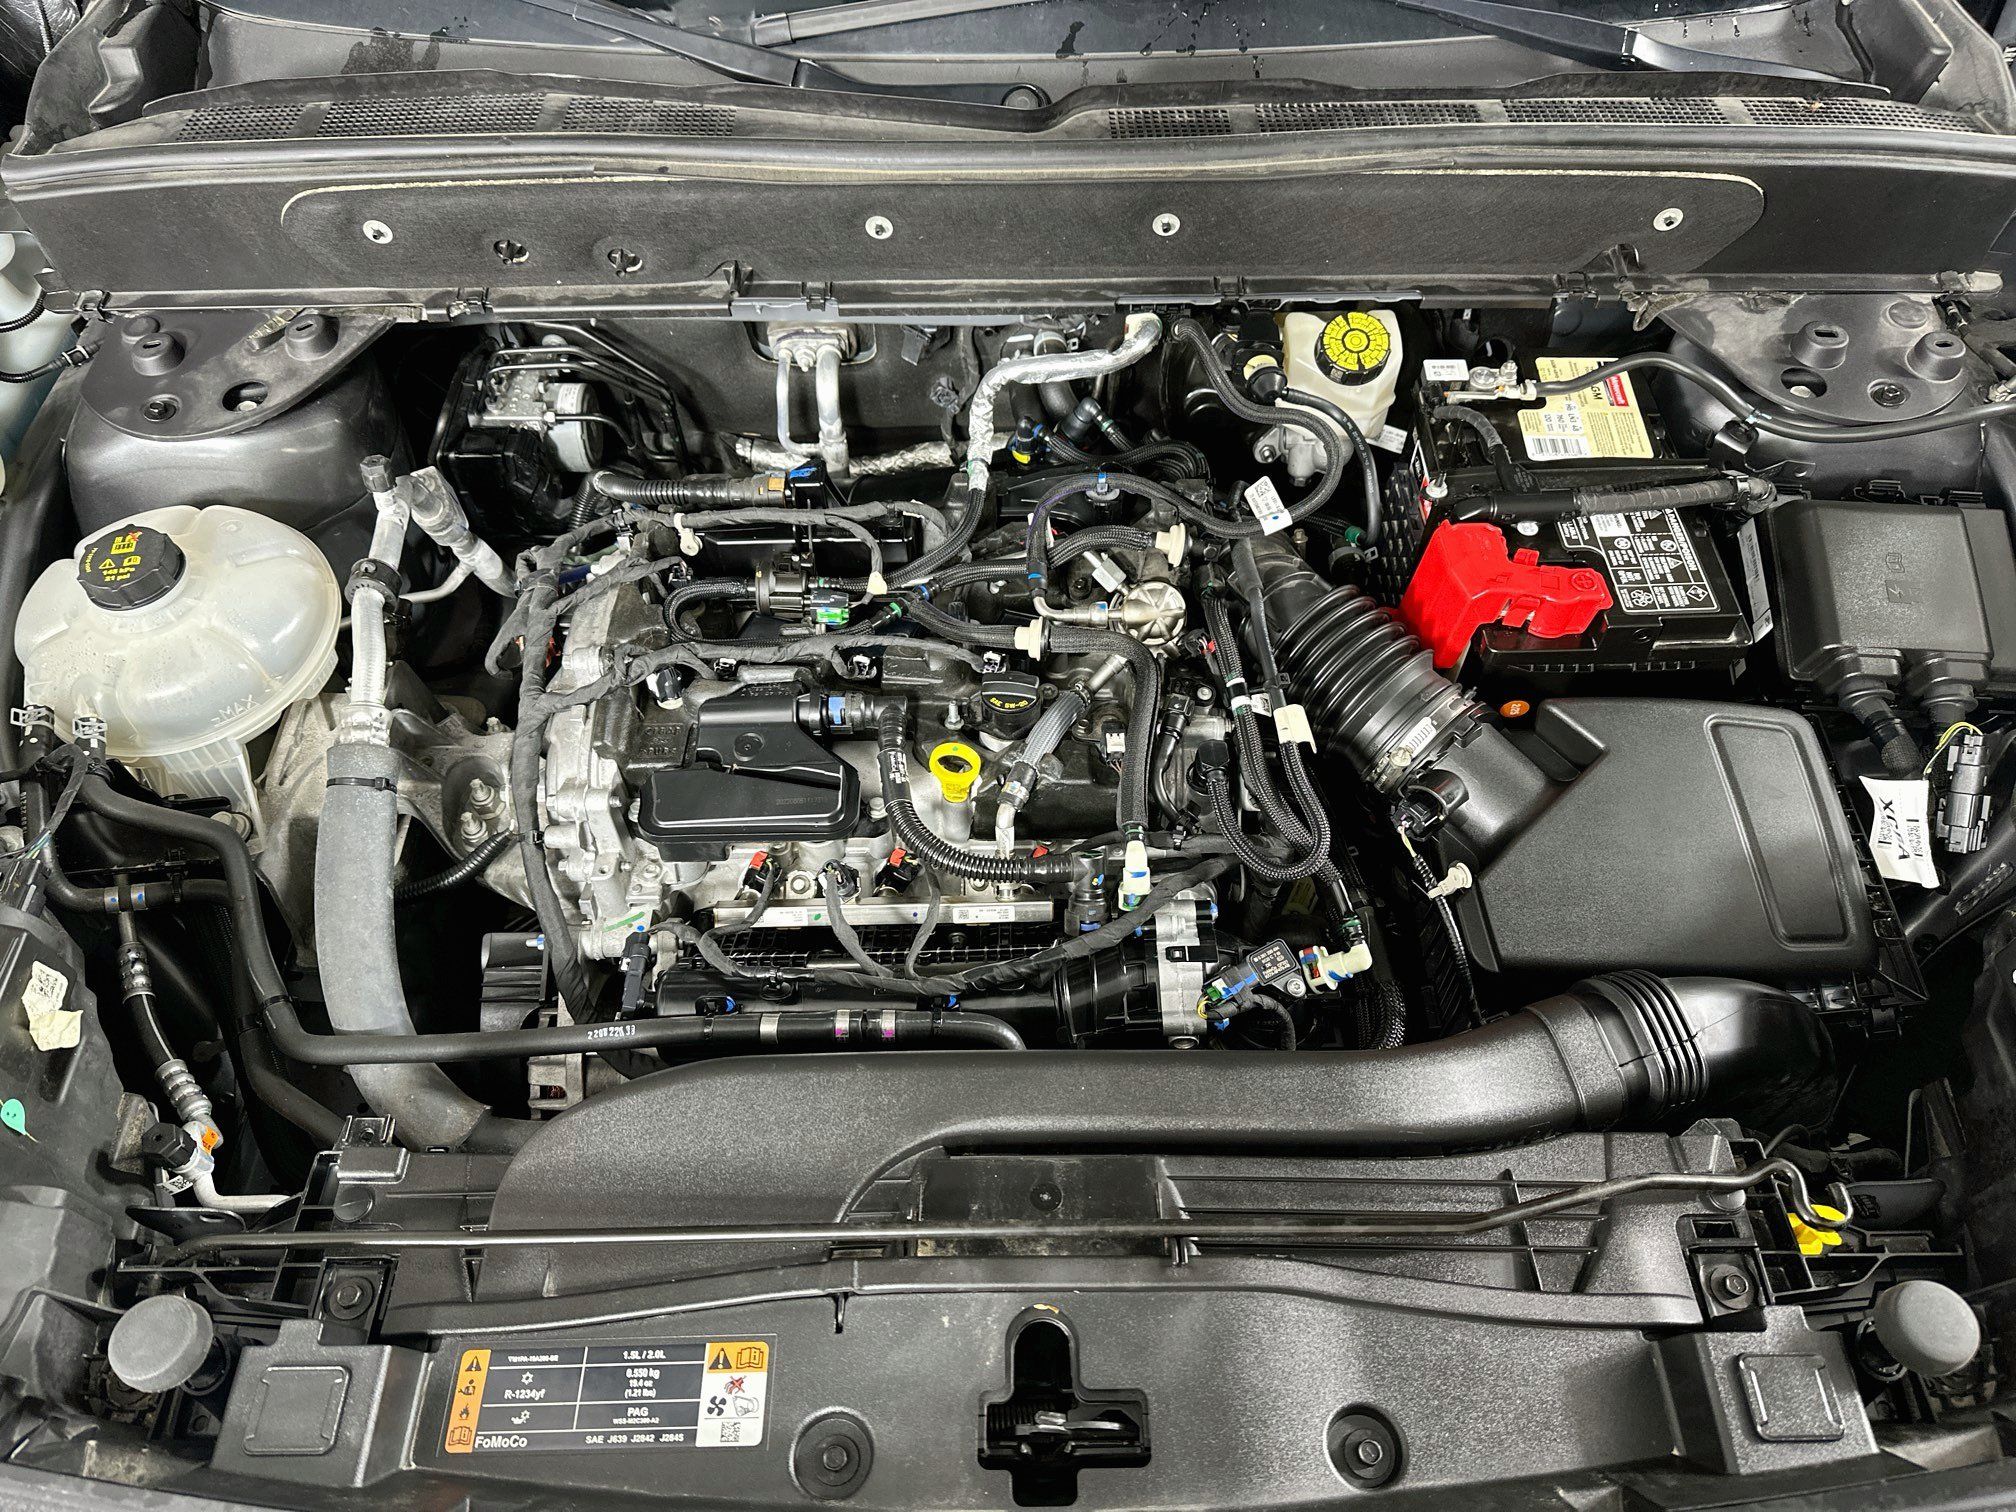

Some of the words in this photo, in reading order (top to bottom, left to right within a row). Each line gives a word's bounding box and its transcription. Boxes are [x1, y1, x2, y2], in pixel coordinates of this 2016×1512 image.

[1667, 513, 1697, 570] DANGER/POISON
[989, 697, 1003, 707] SAE
[622, 1351, 640, 1360] 1.5L
[647, 1349, 667, 1359] 2.0L
[649, 1367, 661, 1380] kg
[504, 1387, 546, 1401] R-1234yf
[626, 1406, 649, 1418] PAG
[474, 1435, 528, 1449] FoMoCo
[584, 1435, 604, 1445] SAE
[606, 1434, 628, 1445] J639
